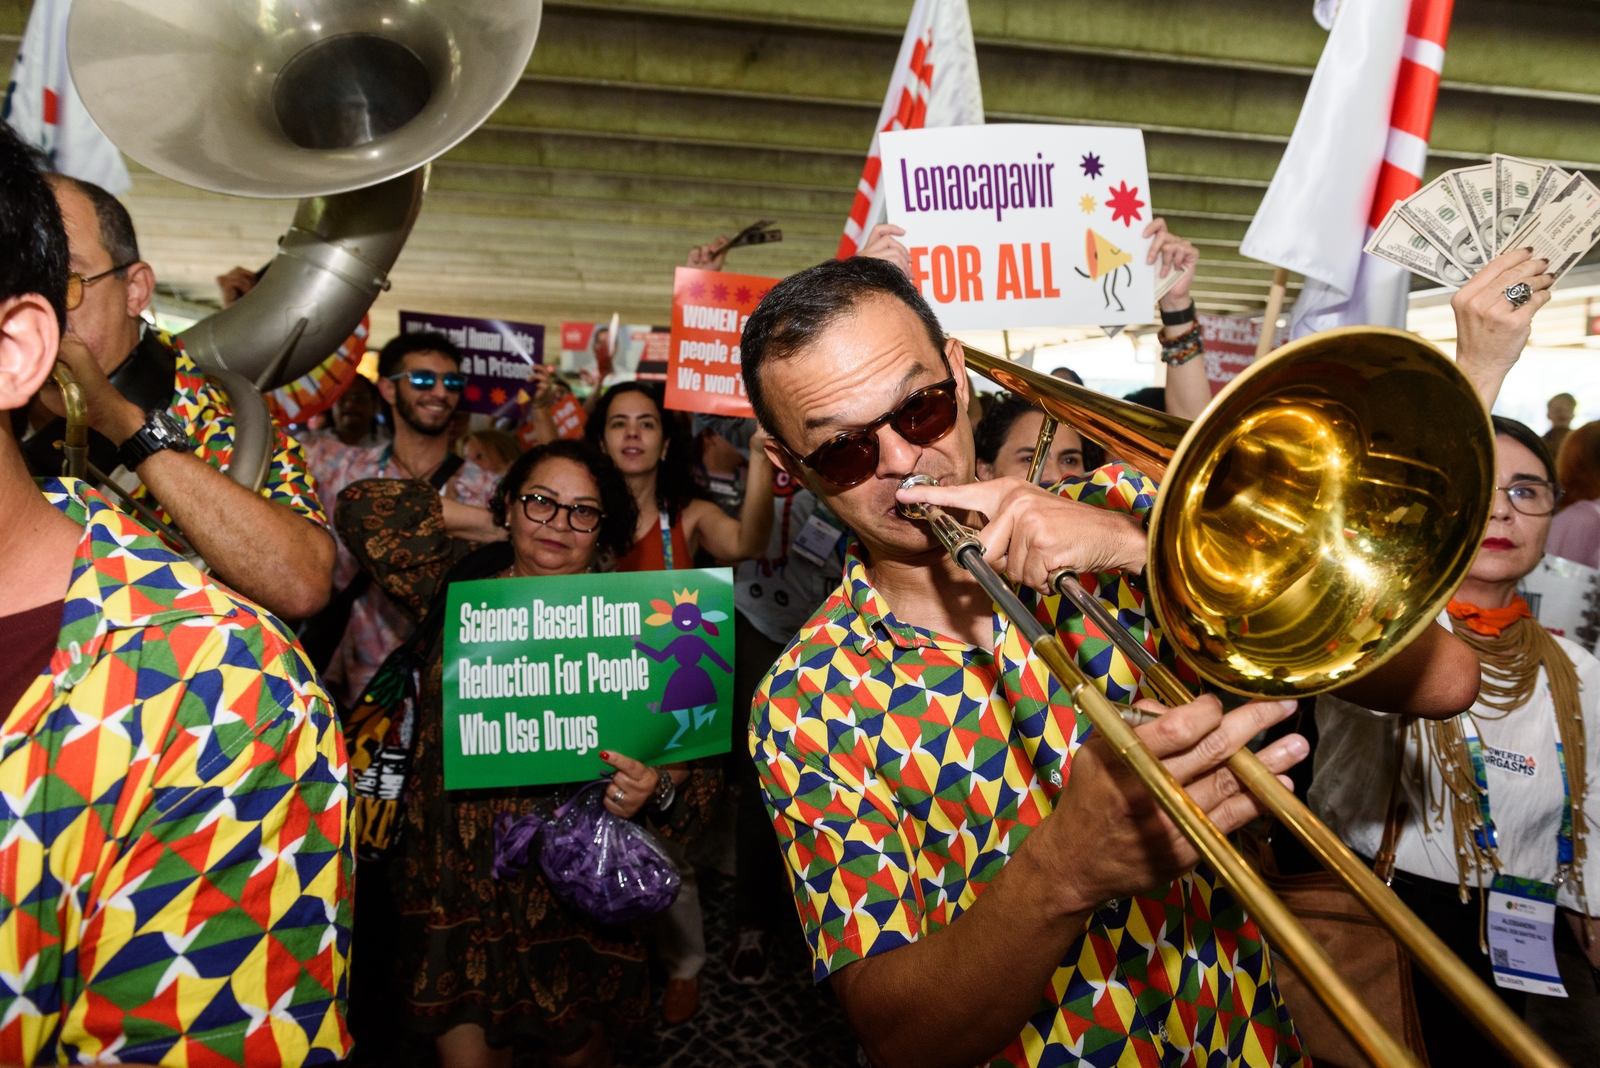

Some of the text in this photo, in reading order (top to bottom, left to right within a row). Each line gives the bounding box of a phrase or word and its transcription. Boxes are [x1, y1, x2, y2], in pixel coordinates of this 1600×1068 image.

[900, 152, 1055, 222] Lenacapavir
[909, 242, 1061, 304] FOR ALL
[682, 304, 739, 333] WOMEN
[468, 326, 502, 351] Human
[679, 339, 729, 366] people
[473, 354, 487, 376] In
[677, 366, 702, 391] We
[459, 596, 641, 644] Science Based Harm
[458, 649, 649, 700] Reduction For People
[459, 710, 599, 756] Who Use Drugs
[1489, 747, 1526, 763] OWERED
